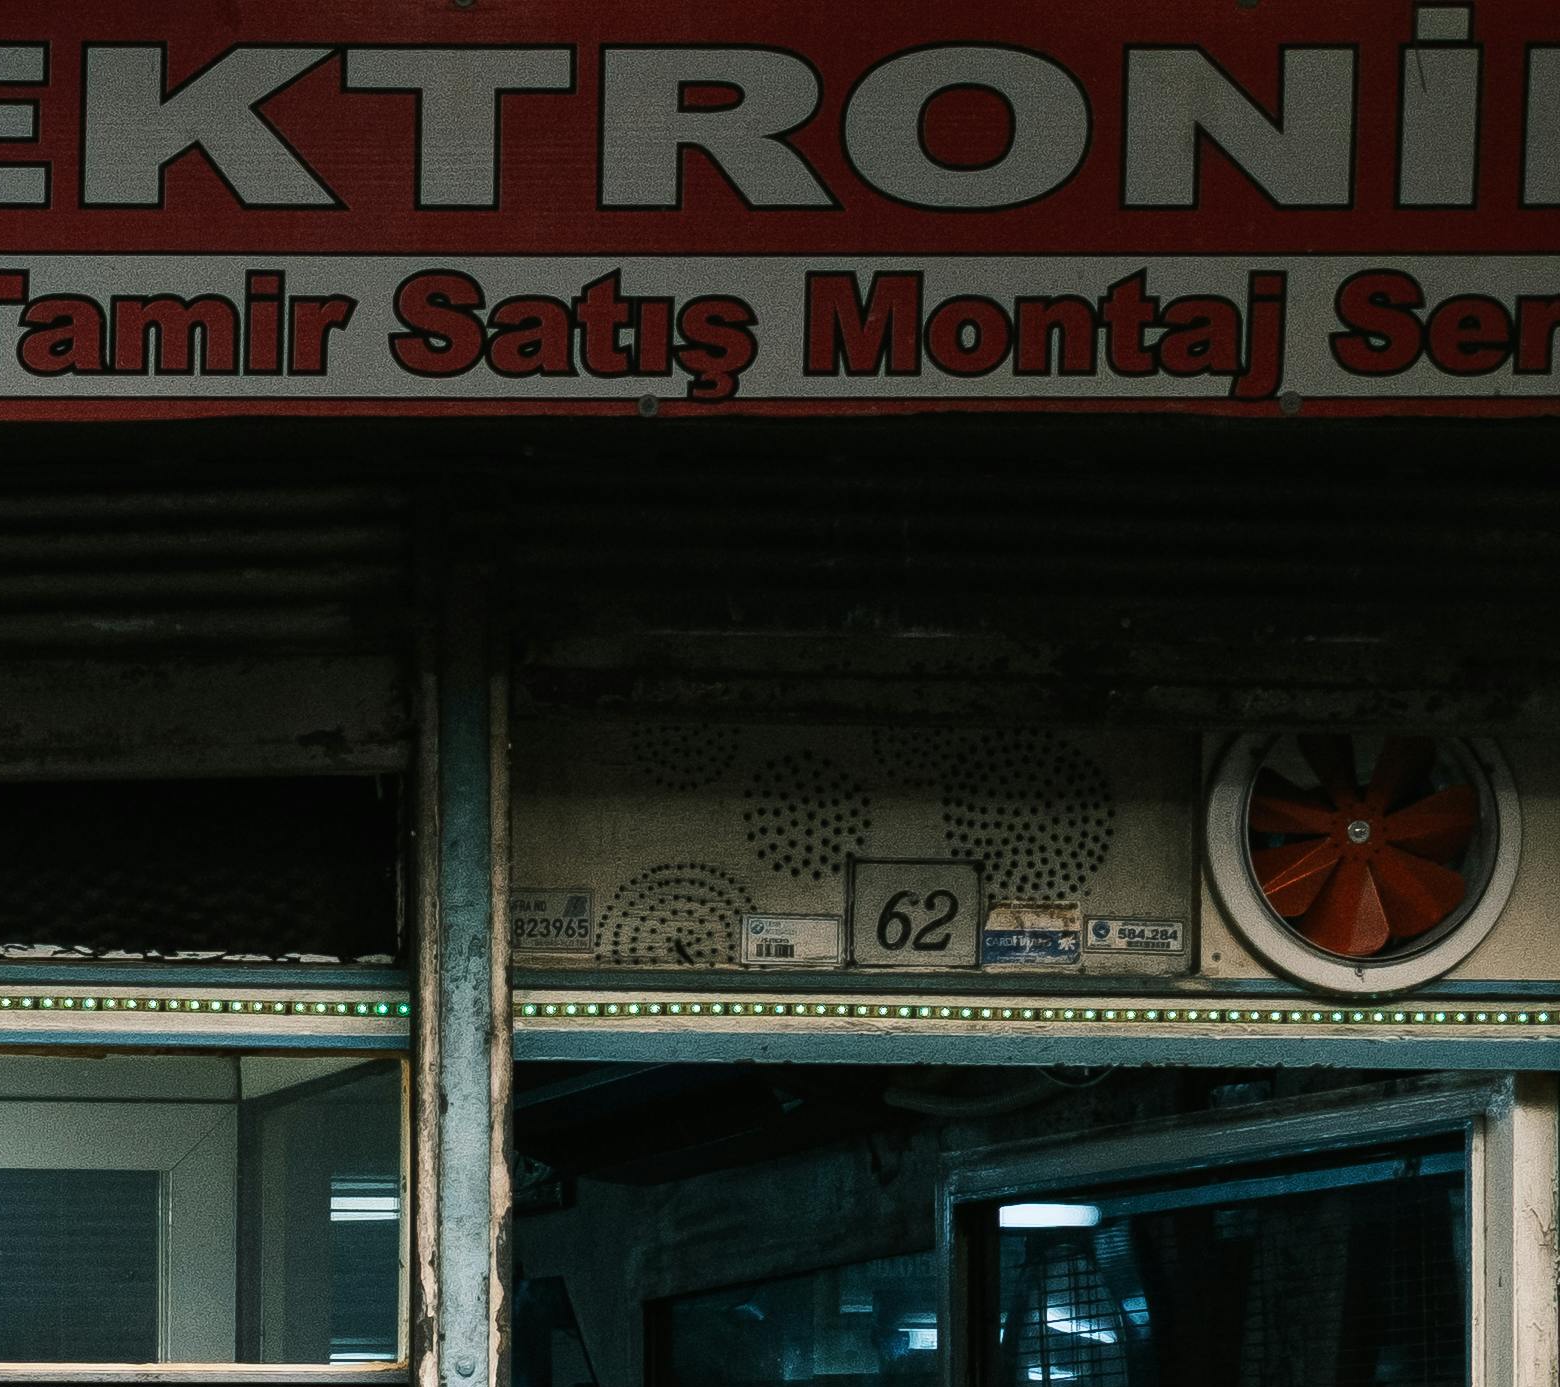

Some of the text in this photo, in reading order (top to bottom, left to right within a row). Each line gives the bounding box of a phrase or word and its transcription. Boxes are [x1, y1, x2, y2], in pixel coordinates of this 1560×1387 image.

[387, 265, 759, 401] Satış
[801, 265, 1289, 402] Montaj
[513, 917, 589, 939] 823965
[876, 888, 960, 953] 62
